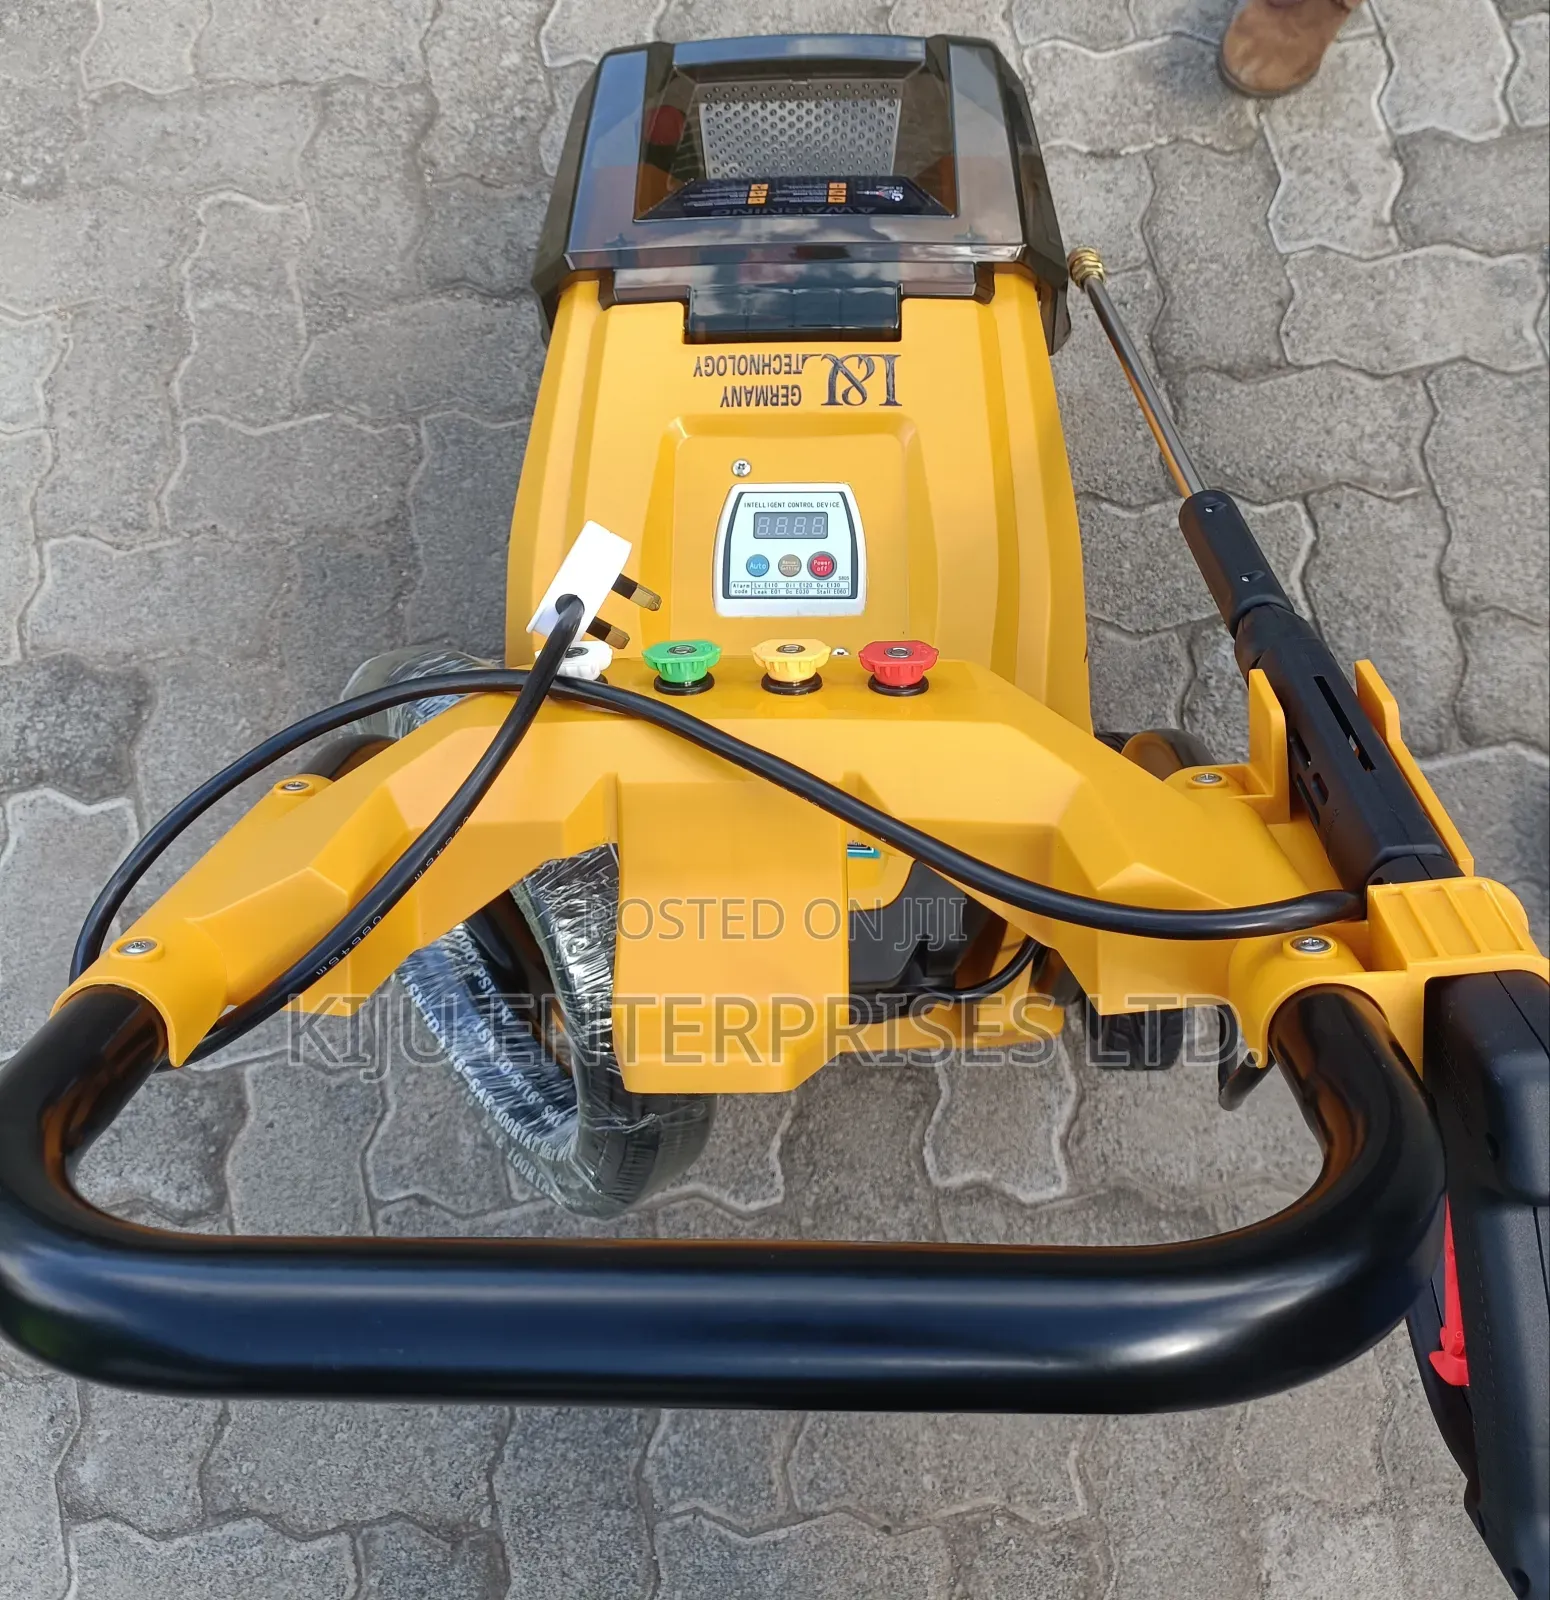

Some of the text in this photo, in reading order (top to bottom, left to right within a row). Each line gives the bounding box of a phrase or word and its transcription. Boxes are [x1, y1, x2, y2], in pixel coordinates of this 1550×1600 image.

[711, 206, 855, 216] WARNING
[693, 353, 803, 378] TECHNOLOGY
[719, 384, 803, 408] GERMANY
[743, 501, 841, 509] INTELLIGENT CONTROL DEVICE
[749, 561, 767, 570] Auto
[813, 559, 831, 567] Power
